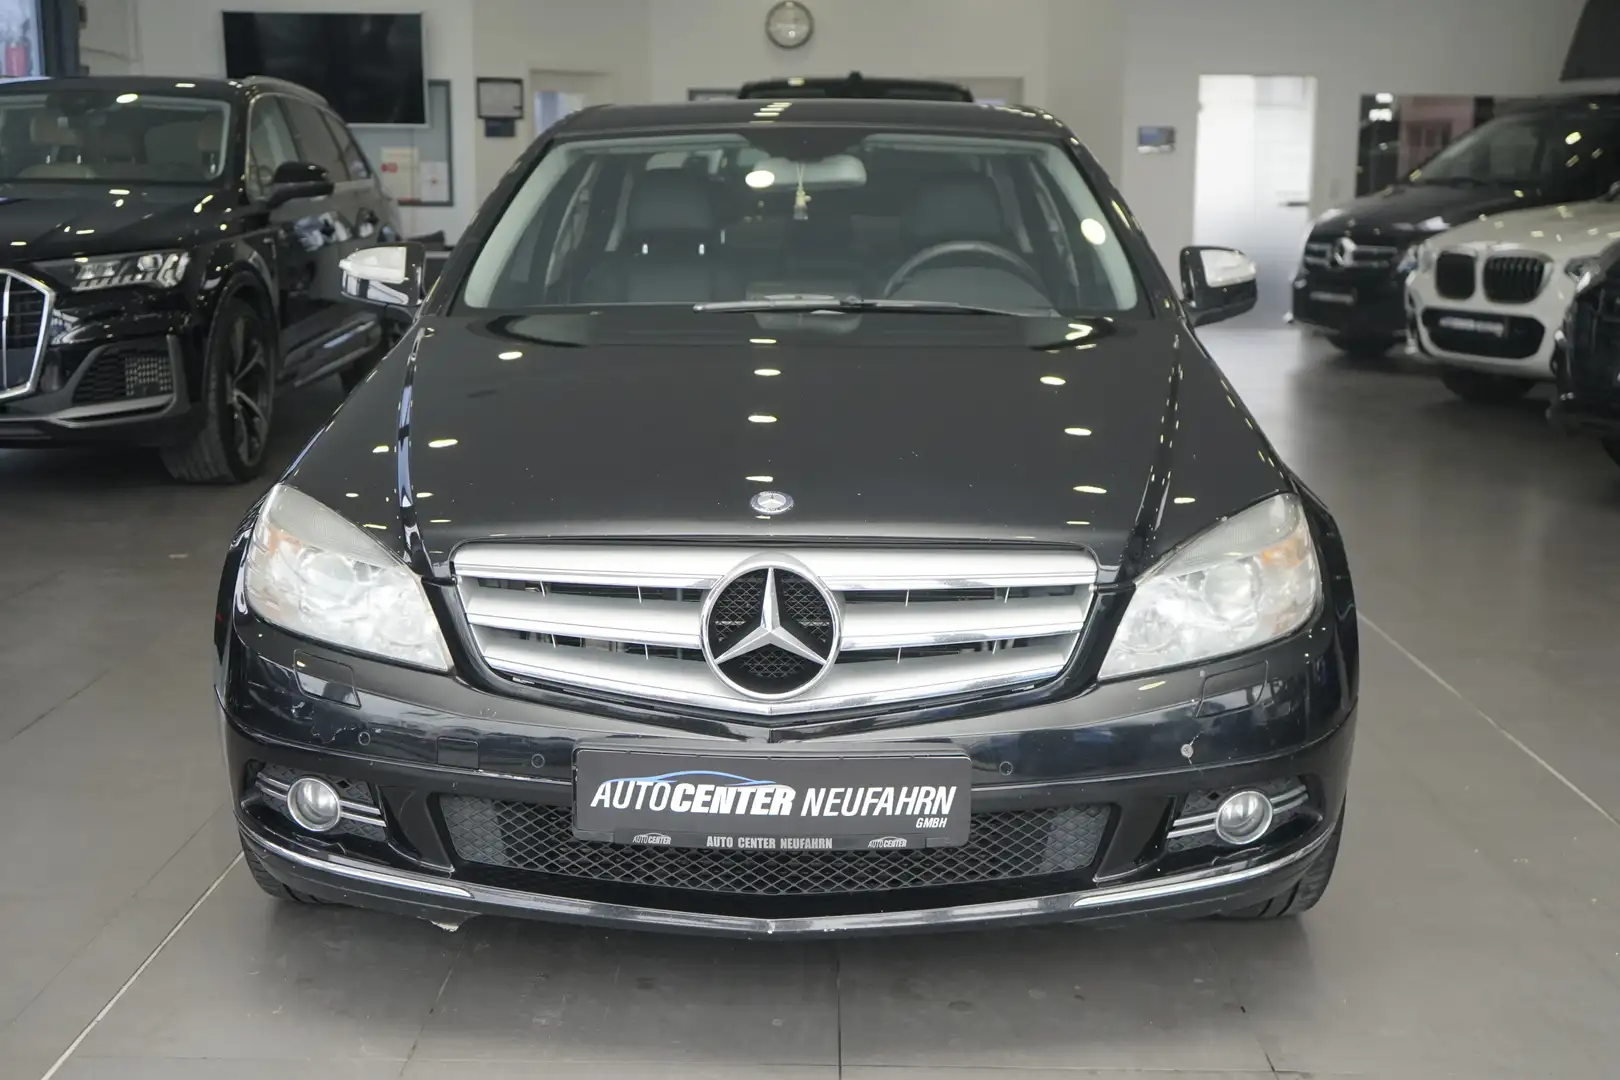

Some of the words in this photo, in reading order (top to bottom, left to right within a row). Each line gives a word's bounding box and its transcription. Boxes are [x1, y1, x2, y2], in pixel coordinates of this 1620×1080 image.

[801, 786, 957, 817] NEUFAHRN
[915, 817, 948, 829] GMBH
[706, 836, 734, 848] AUTO
[738, 837, 776, 849] CENTER
[780, 837, 833, 850] NEUFAHRN
